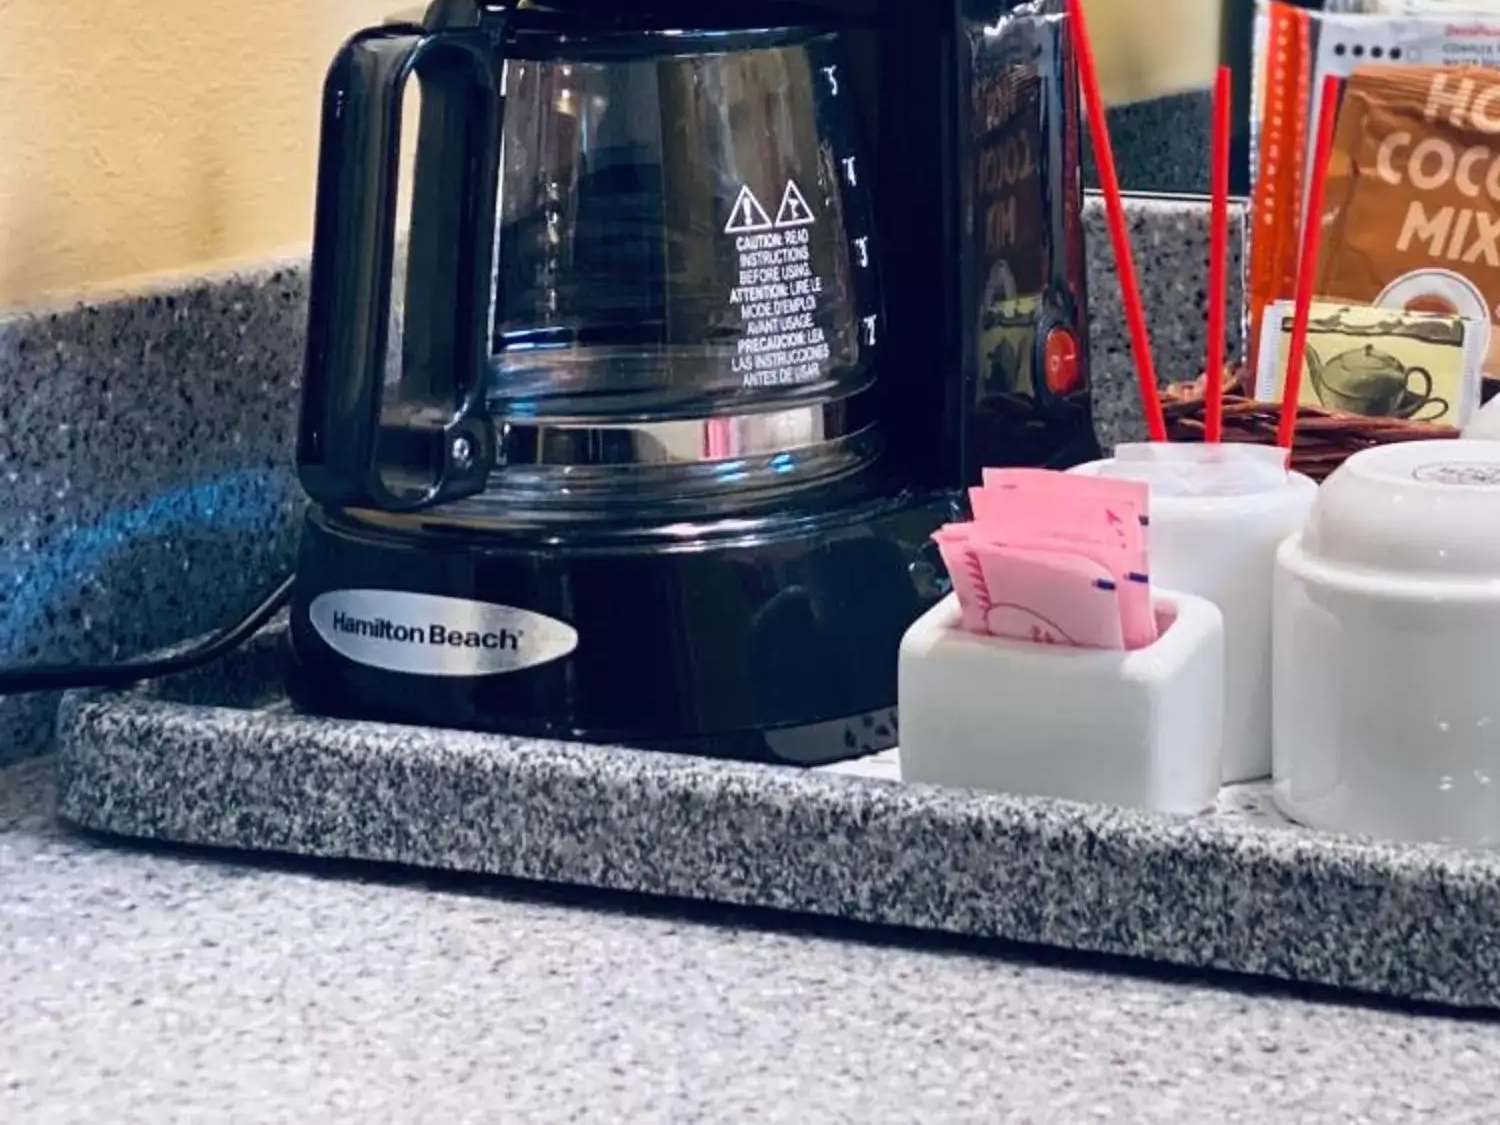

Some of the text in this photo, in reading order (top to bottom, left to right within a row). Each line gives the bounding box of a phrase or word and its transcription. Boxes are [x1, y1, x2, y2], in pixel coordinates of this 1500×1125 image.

[784, 228, 809, 245] READ
[739, 245, 809, 268] INSTRUCTIONS
[739, 267, 780, 286] BEFORE
[790, 278, 810, 296] LIRE
[811, 276, 822, 292] LE
[741, 294, 816, 320] MODE D'EMPLOI
[747, 318, 779, 335] AVANT
[807, 327, 825, 344] LEA
[732, 342, 830, 373] LAS INSTRUCCIONES
[743, 370, 777, 388] ANTES
[779, 367, 794, 384] DE
[333, 610, 519, 650] Hamilton Beach
